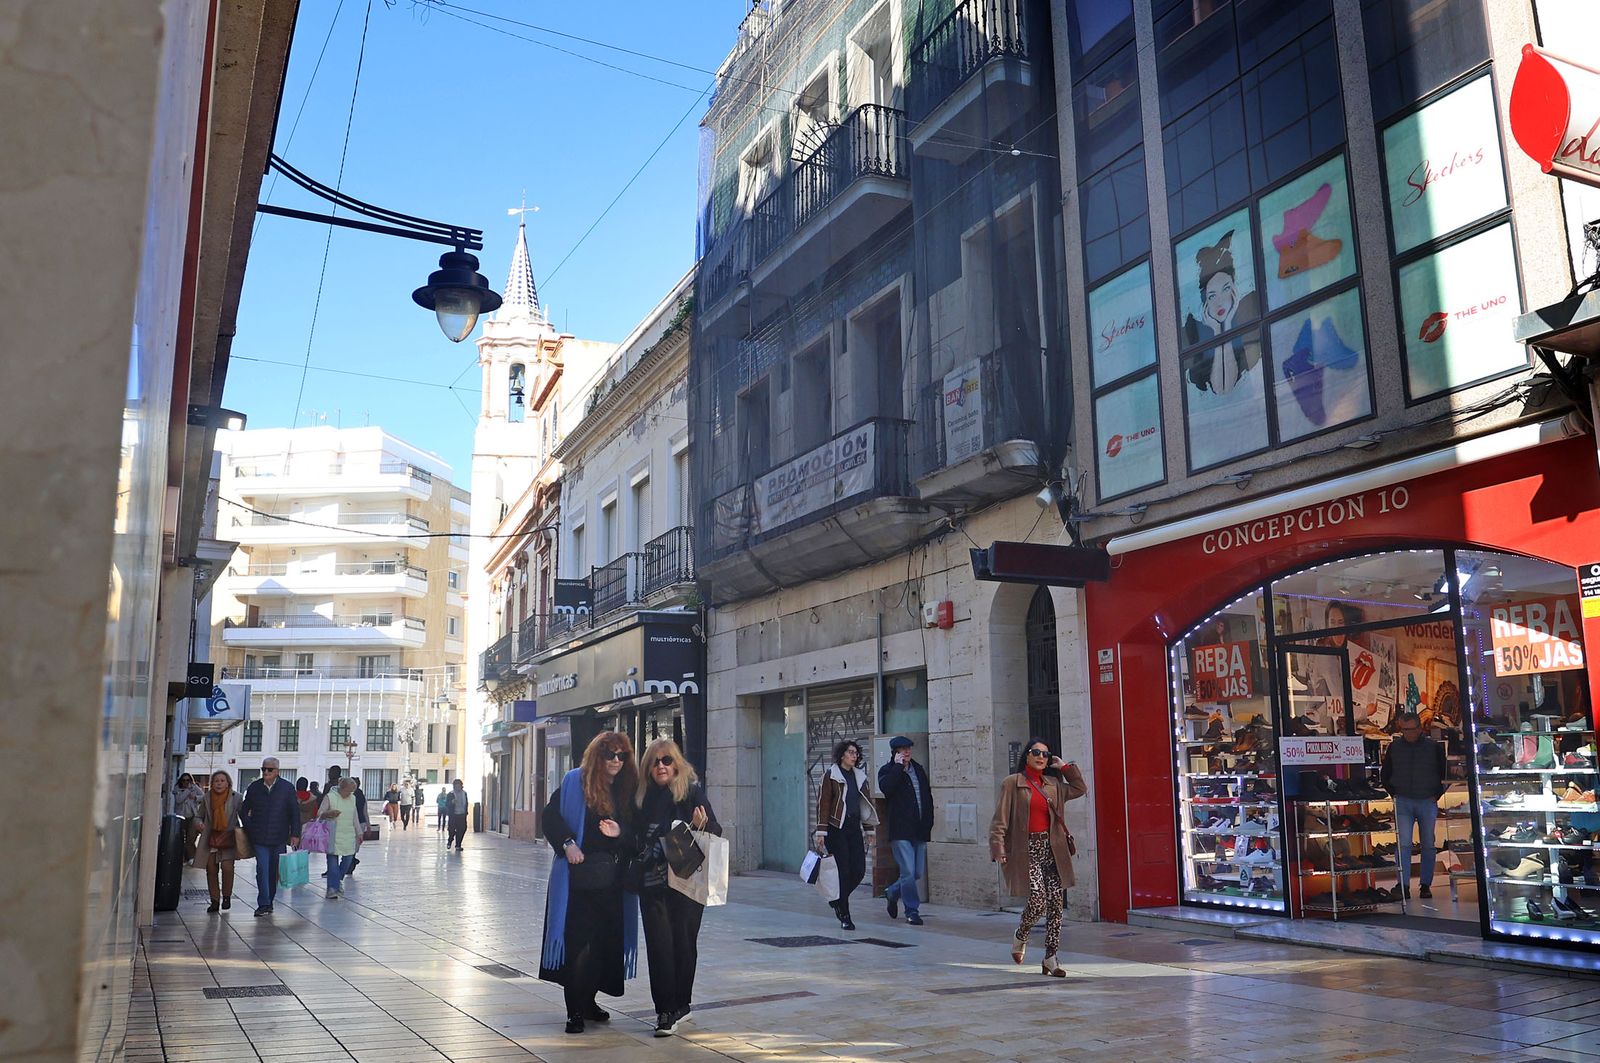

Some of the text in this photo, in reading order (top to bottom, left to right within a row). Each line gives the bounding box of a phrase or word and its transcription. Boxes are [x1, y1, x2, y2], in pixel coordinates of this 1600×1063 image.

[1403, 147, 1484, 207] Skechers
[1454, 295, 1507, 320] THE UNO
[1126, 432, 1139, 442] THE
[1140, 427, 1156, 437] UNO
[768, 432, 868, 493] PROMOCIÓN
[1202, 486, 1409, 554] CONCEPCIÓN 10
[1494, 599, 1580, 643] REBA
[1195, 645, 1246, 678] REBA
[1502, 644, 1539, 672] 50%
[1540, 639, 1584, 669] JAS
[187, 676, 210, 685] GO
[1221, 676, 1249, 698] JAS
[1283, 747, 1305, 758] -50%
[1343, 746, 1363, 756] -50%
